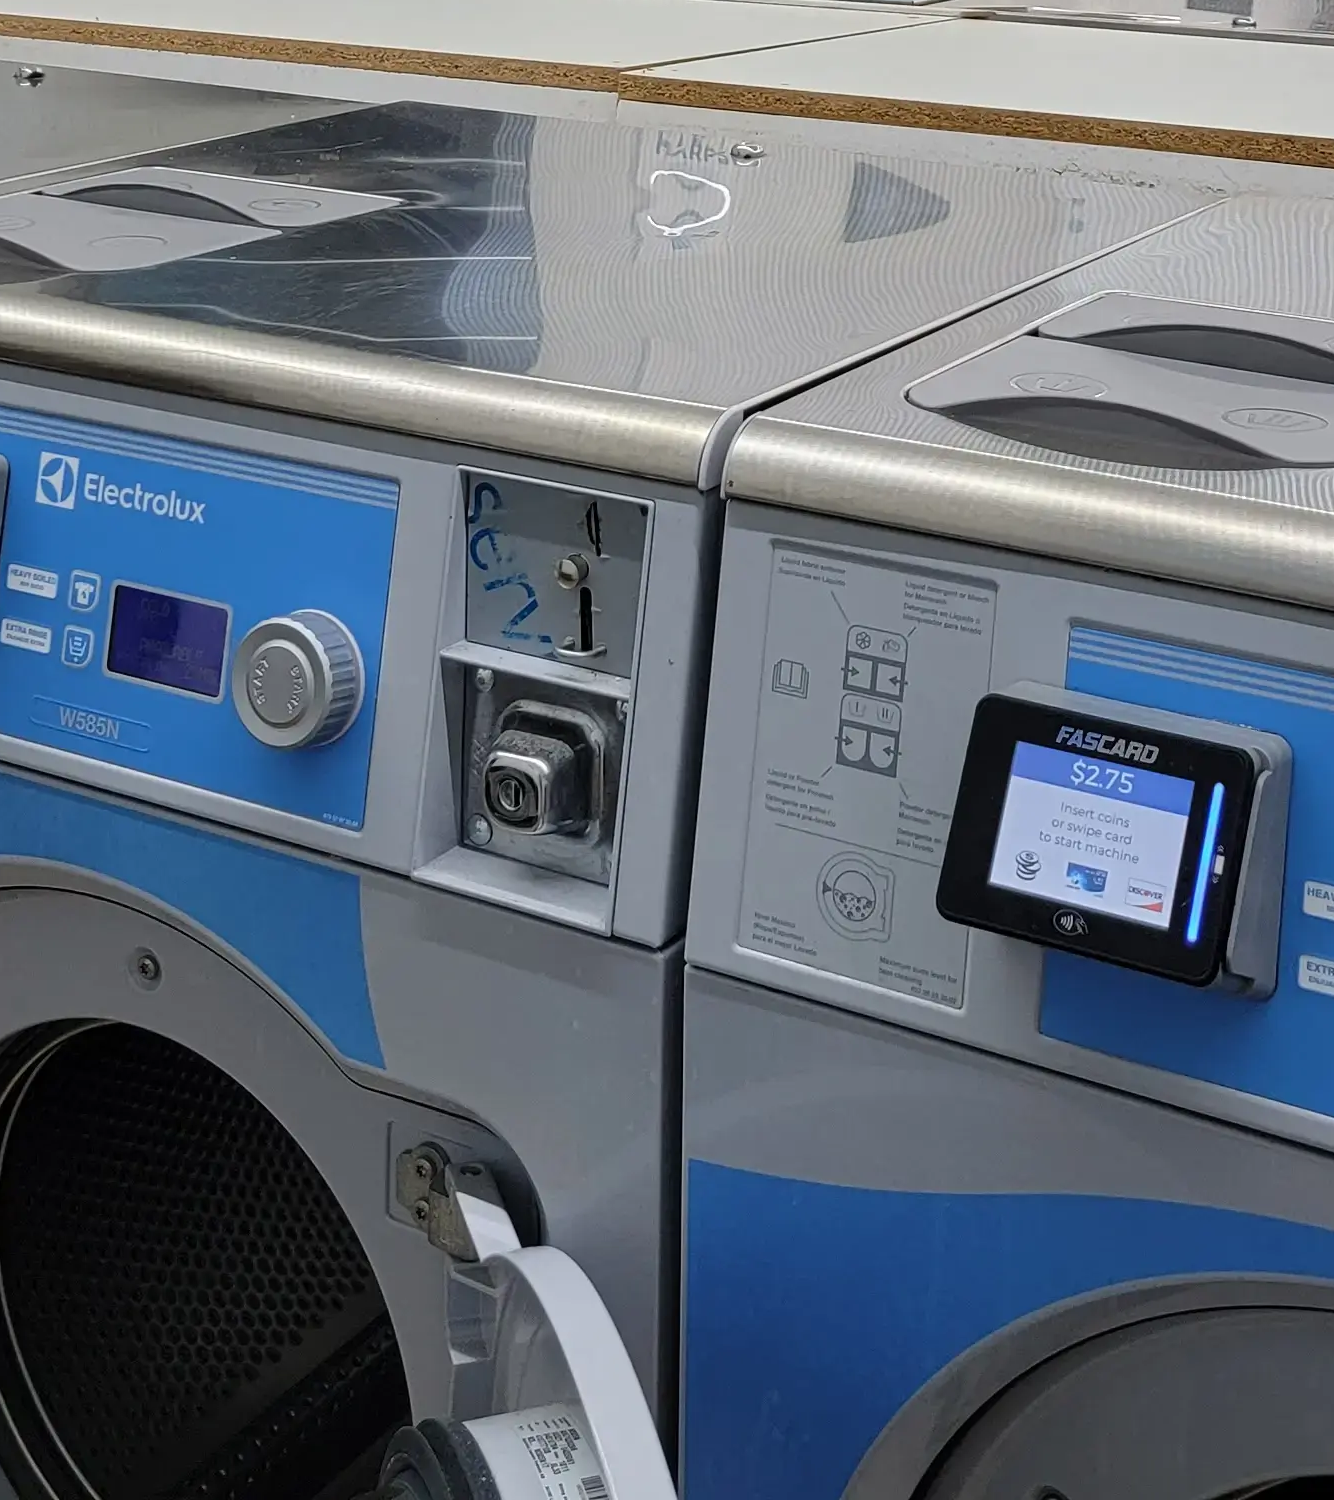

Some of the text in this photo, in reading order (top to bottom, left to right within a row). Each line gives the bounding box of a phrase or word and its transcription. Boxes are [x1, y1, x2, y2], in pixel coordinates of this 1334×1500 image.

[83, 472, 206, 524] Electrolux
[10, 568, 56, 584] HEAVY SOILED
[6, 622, 48, 639] EXTRA RINSE
[252, 657, 268, 704] START
[59, 706, 119, 739] W585N
[1055, 725, 1159, 764] FASCARD
[1070, 758, 1135, 794] $2.75
[1060, 802, 1131, 828] Insert coins
[1039, 830, 1139, 864] to start machine
[1051, 819, 1133, 845] or swipe card
[1128, 885, 1163, 900] DISCOVER
